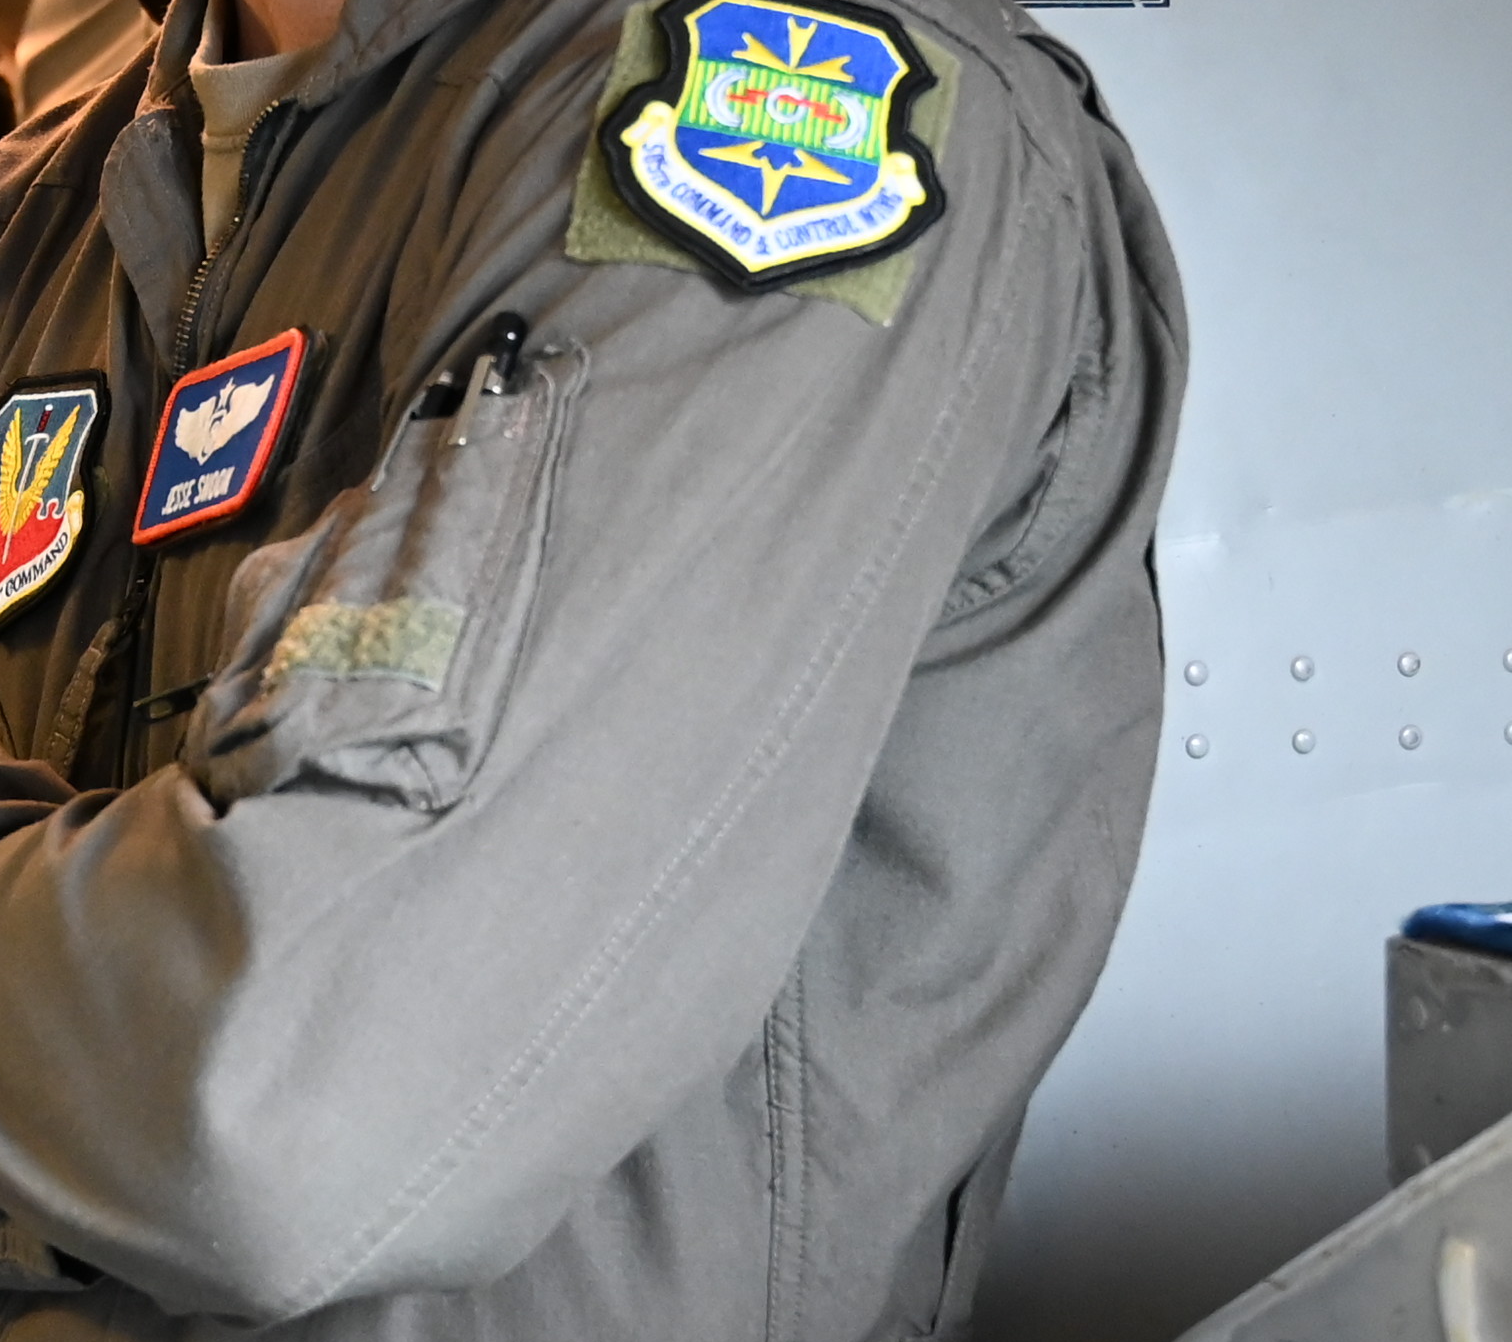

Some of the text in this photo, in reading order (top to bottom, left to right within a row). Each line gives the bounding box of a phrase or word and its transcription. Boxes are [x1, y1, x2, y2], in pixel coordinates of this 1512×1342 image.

[671, 182, 752, 245] COMMAND
[776, 215, 860, 249] CONTROL
[161, 478, 197, 516] JESSE
[4, 531, 69, 598] COMMAND
